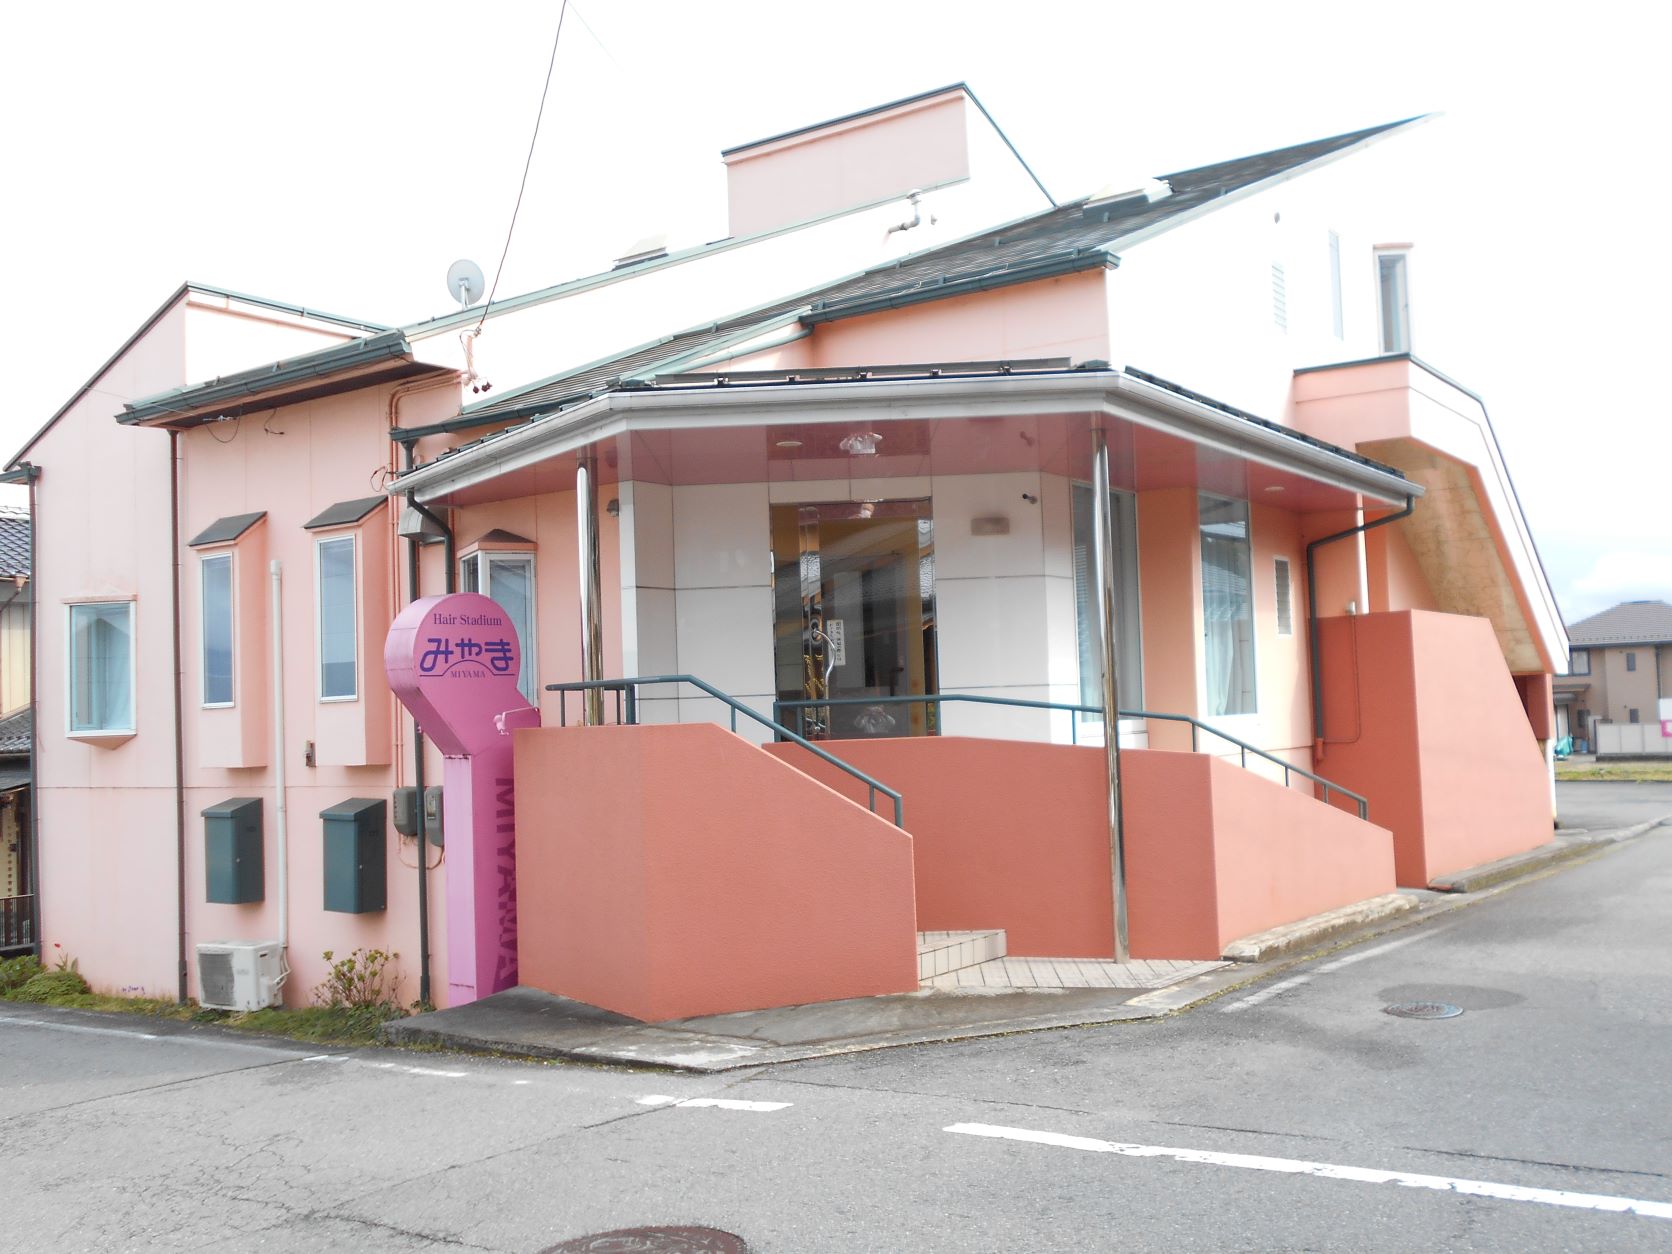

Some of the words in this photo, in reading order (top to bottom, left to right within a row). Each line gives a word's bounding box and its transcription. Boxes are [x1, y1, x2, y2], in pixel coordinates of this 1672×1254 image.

[433, 613, 457, 625] Hair
[459, 614, 502, 626] Stadium
[419, 638, 514, 672] みやま
